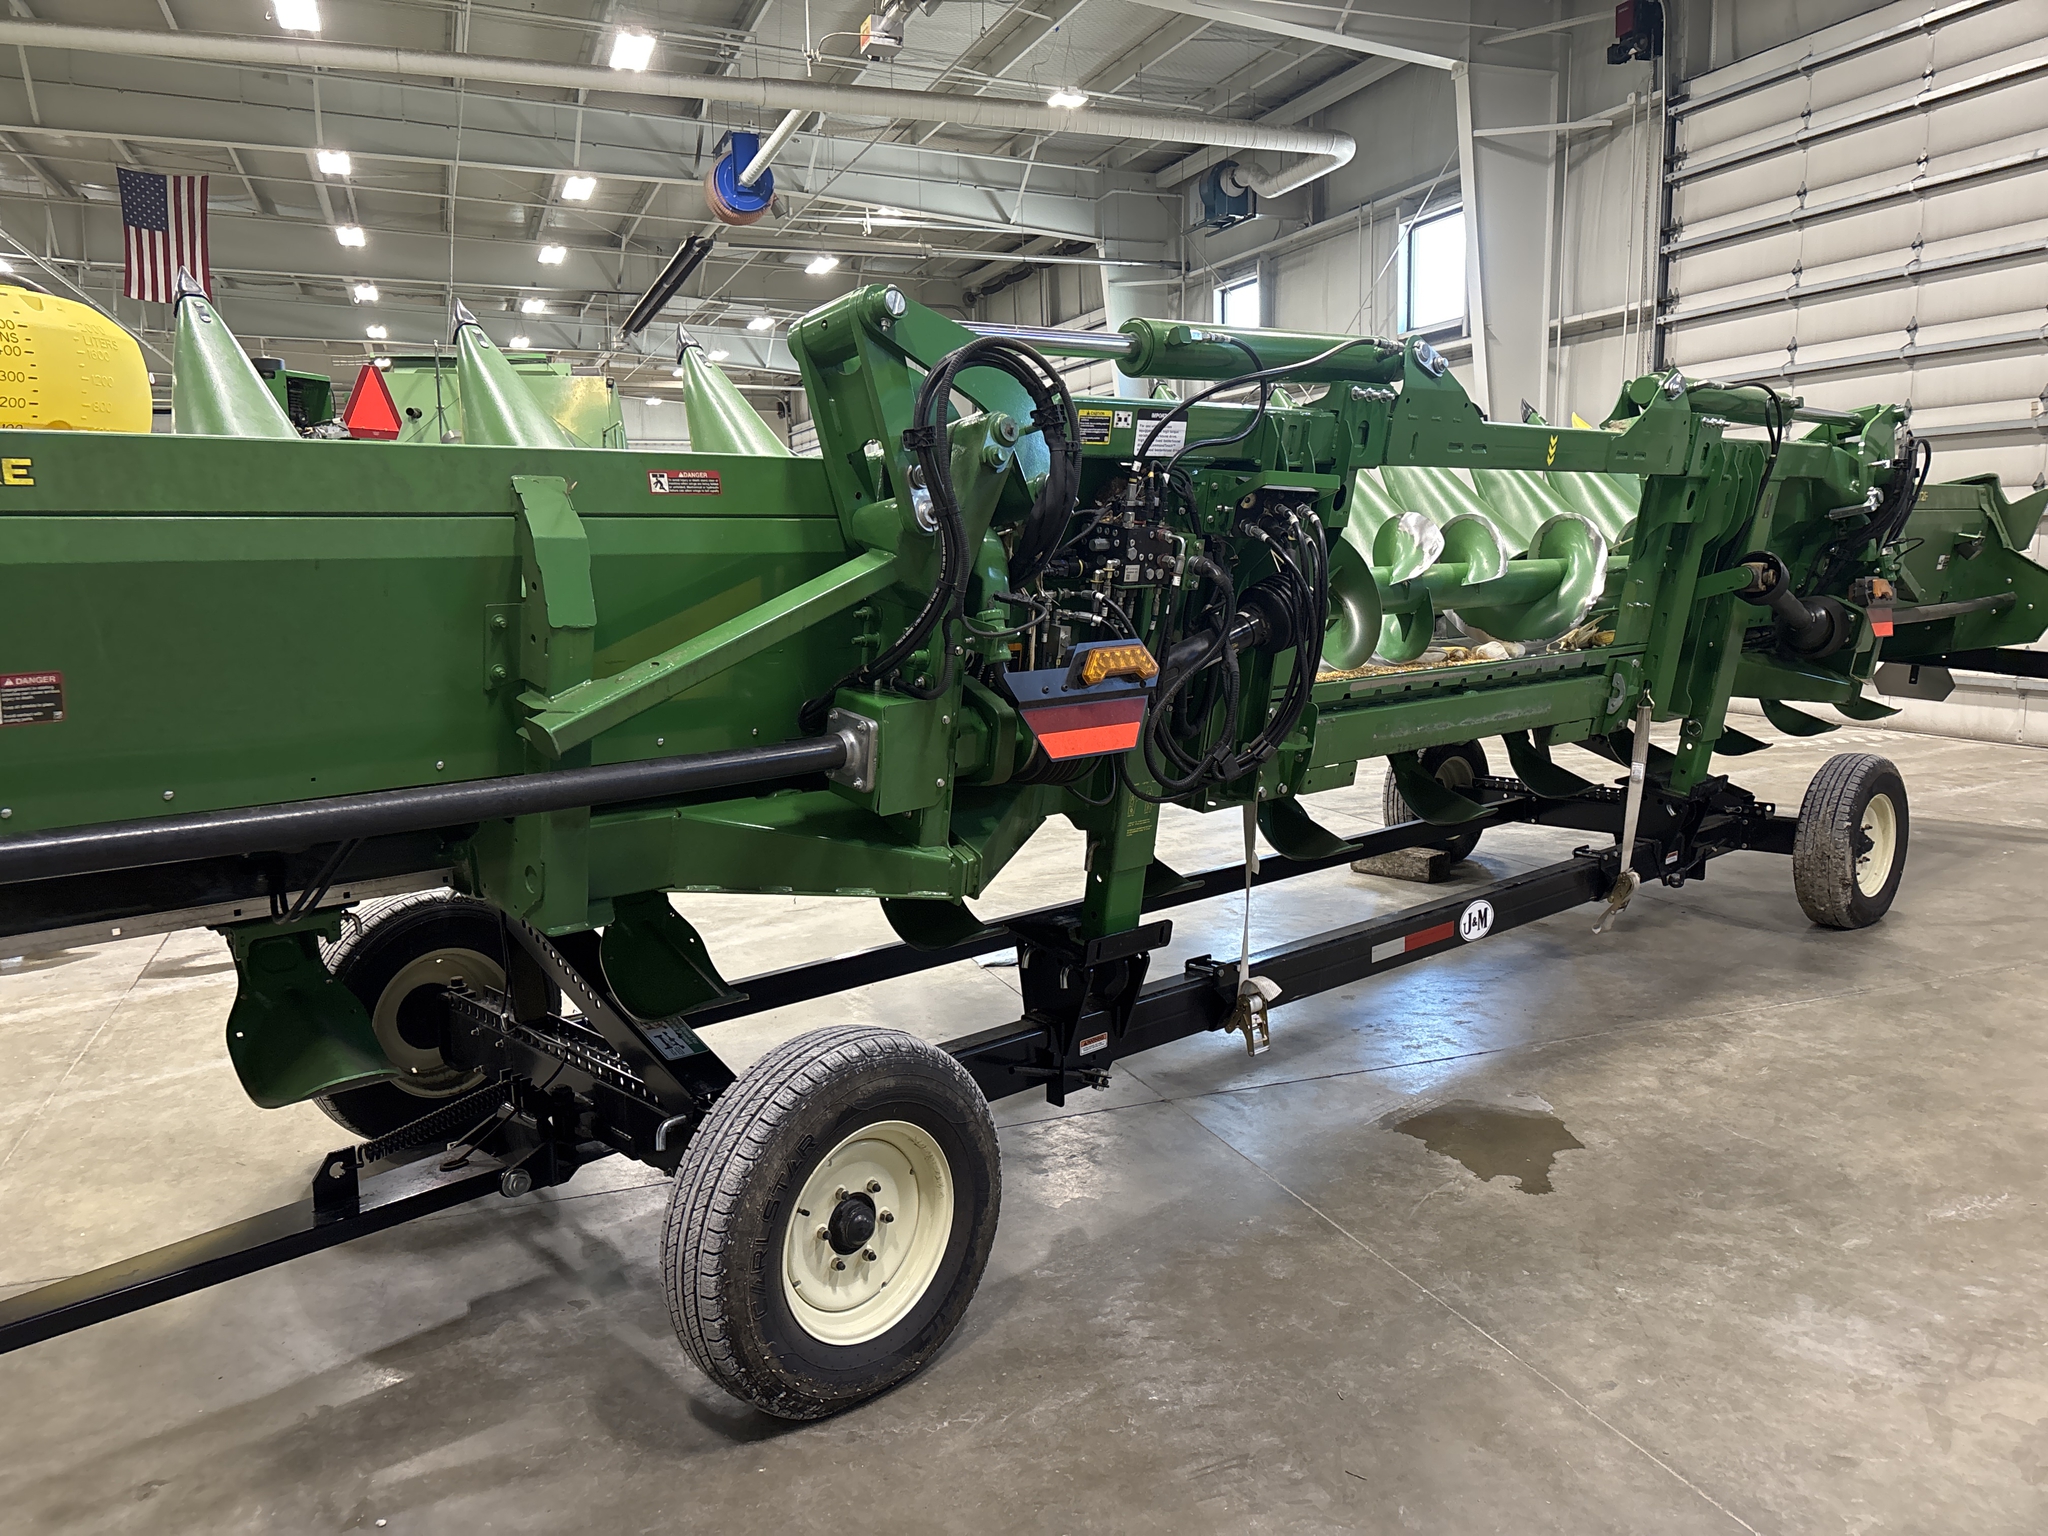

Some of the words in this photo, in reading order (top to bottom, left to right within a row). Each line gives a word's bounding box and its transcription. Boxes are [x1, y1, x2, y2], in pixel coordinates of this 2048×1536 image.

[0, 319, 15, 330] 00
[82, 335, 119, 351] LITERS
[0, 344, 21, 357] 00
[86, 348, 111, 362] 1600
[91, 374, 115, 388] 1200
[0, 396, 26, 409] 200
[92, 401, 113, 413] 800
[0, 457, 36, 487] E
[15, 675, 56, 685] DANGER
[1463, 907, 1489, 935] J&M
[751, 1133, 816, 1321] CARLSTAR
